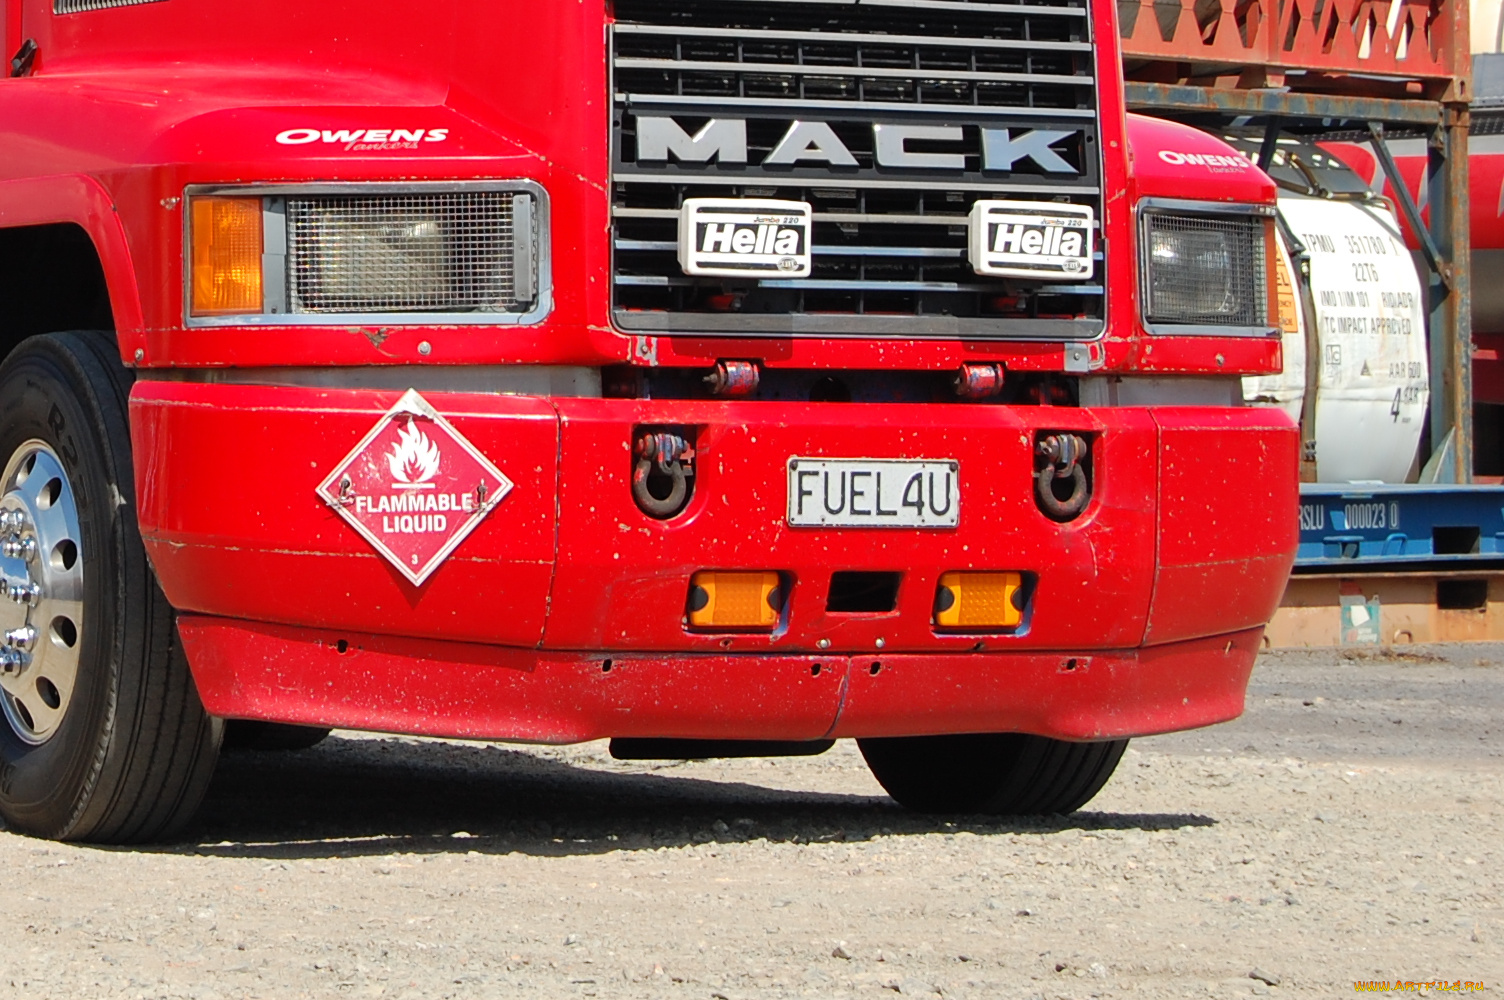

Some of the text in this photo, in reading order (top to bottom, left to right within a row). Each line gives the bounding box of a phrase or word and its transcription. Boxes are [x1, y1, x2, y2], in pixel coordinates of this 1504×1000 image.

[275, 128, 449, 145] OWENS
[635, 115, 1080, 174] MACK
[1158, 150, 1249, 168] OWENS
[1067, 219, 1083, 227] 220
[702, 223, 799, 255] Hella
[993, 223, 1083, 257] Hella
[1302, 233, 1336, 253] TPMU
[1344, 234, 1386, 255] 351780
[1351, 262, 1379, 283] 22T6
[1324, 316, 1412, 335] TC IMPACT APPROVED
[1390, 386, 1402, 424] 4
[356, 493, 474, 513] FLAMMABLE
[797, 470, 951, 516] FUEL4U
[383, 514, 447, 534] LIQUID
[1344, 503, 1386, 530] 000023
[411, 554, 419, 565] 3
